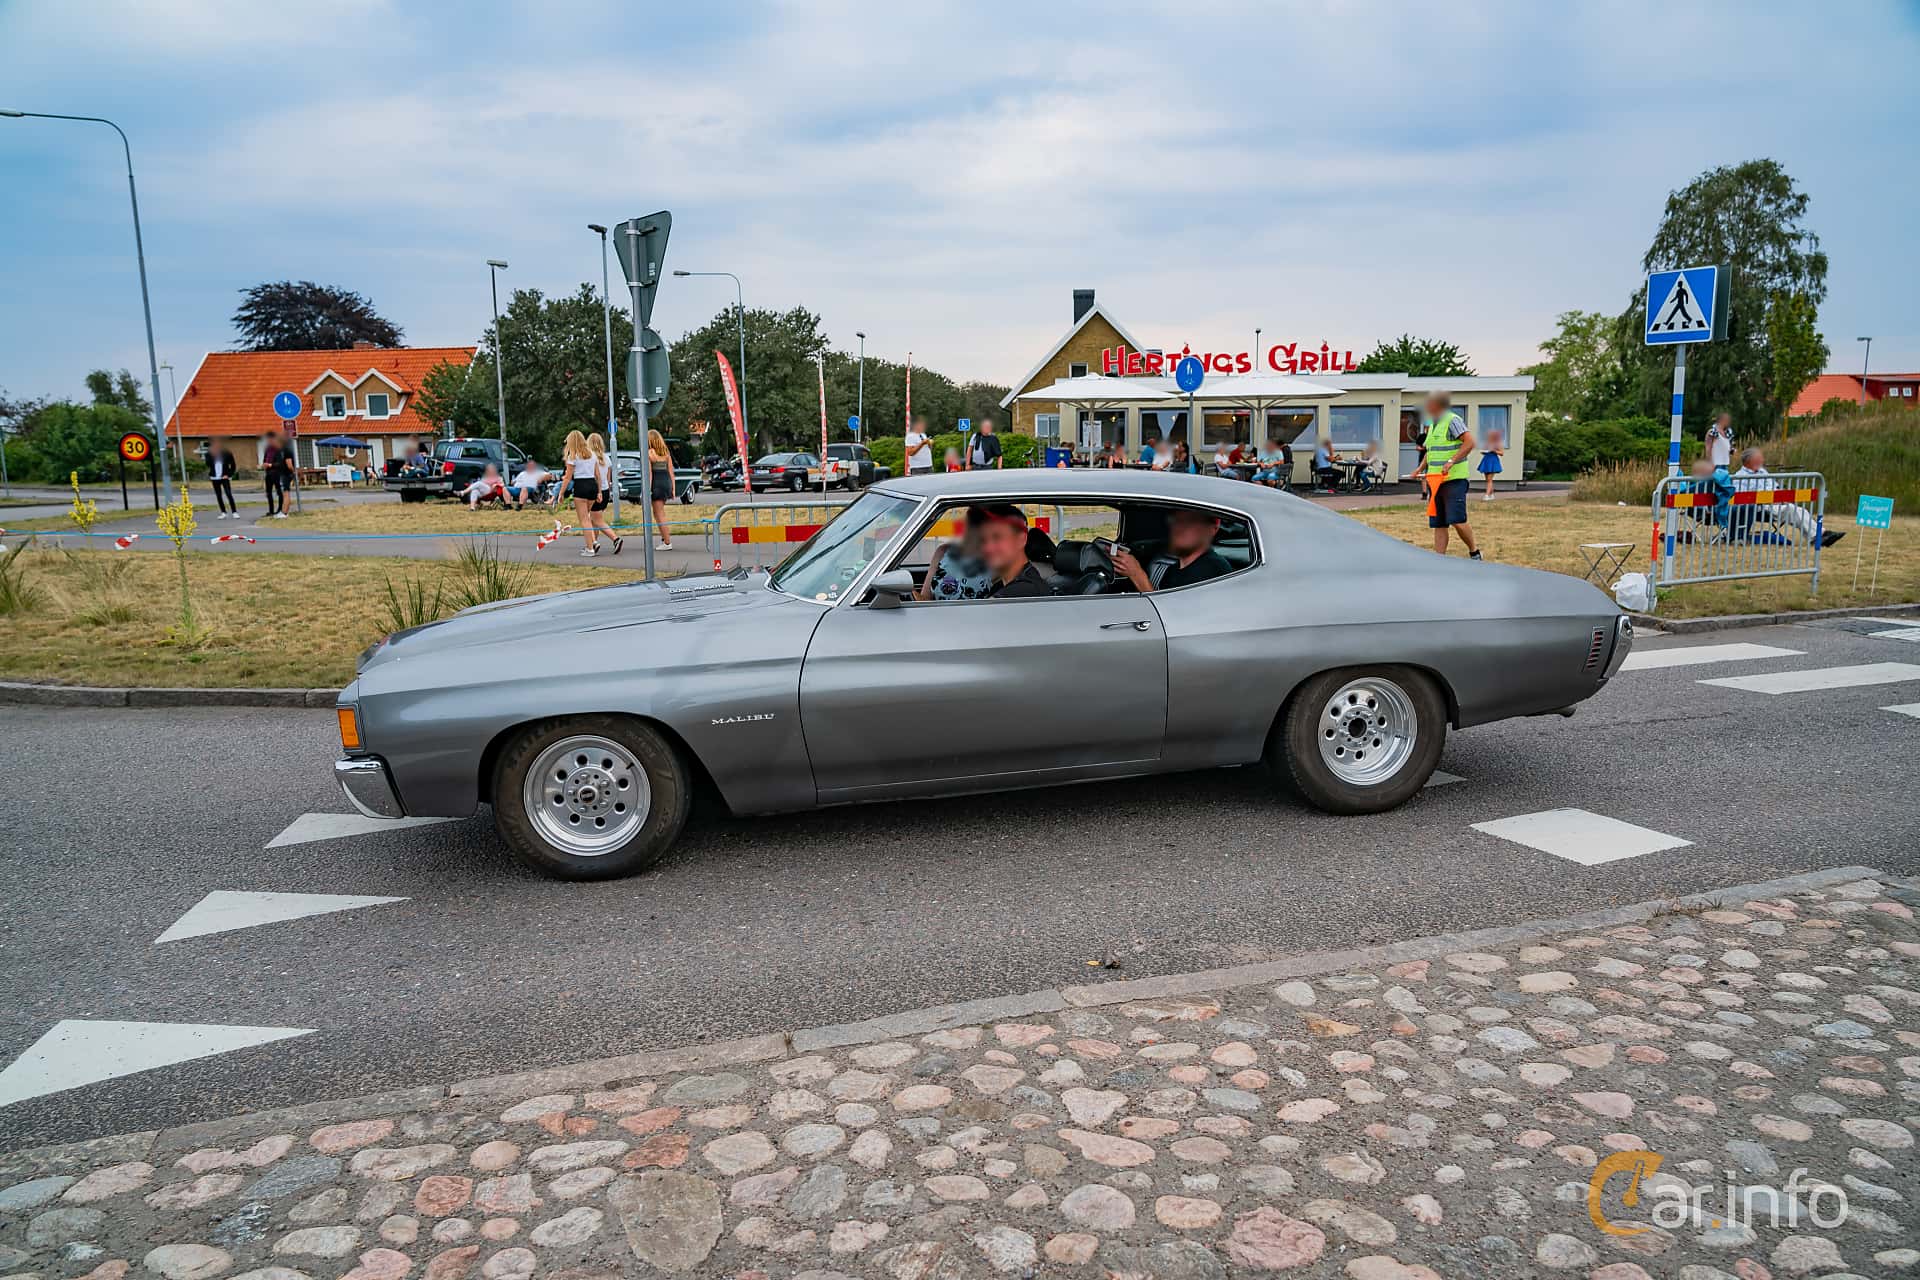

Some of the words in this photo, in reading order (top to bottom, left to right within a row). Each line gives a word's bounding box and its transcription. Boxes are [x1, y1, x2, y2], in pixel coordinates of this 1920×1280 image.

[1102, 342, 1252, 376] HERTNGS
[1268, 342, 1357, 375] GRILL
[126, 440, 145, 454] 30
[711, 713, 775, 725] MALIBU
